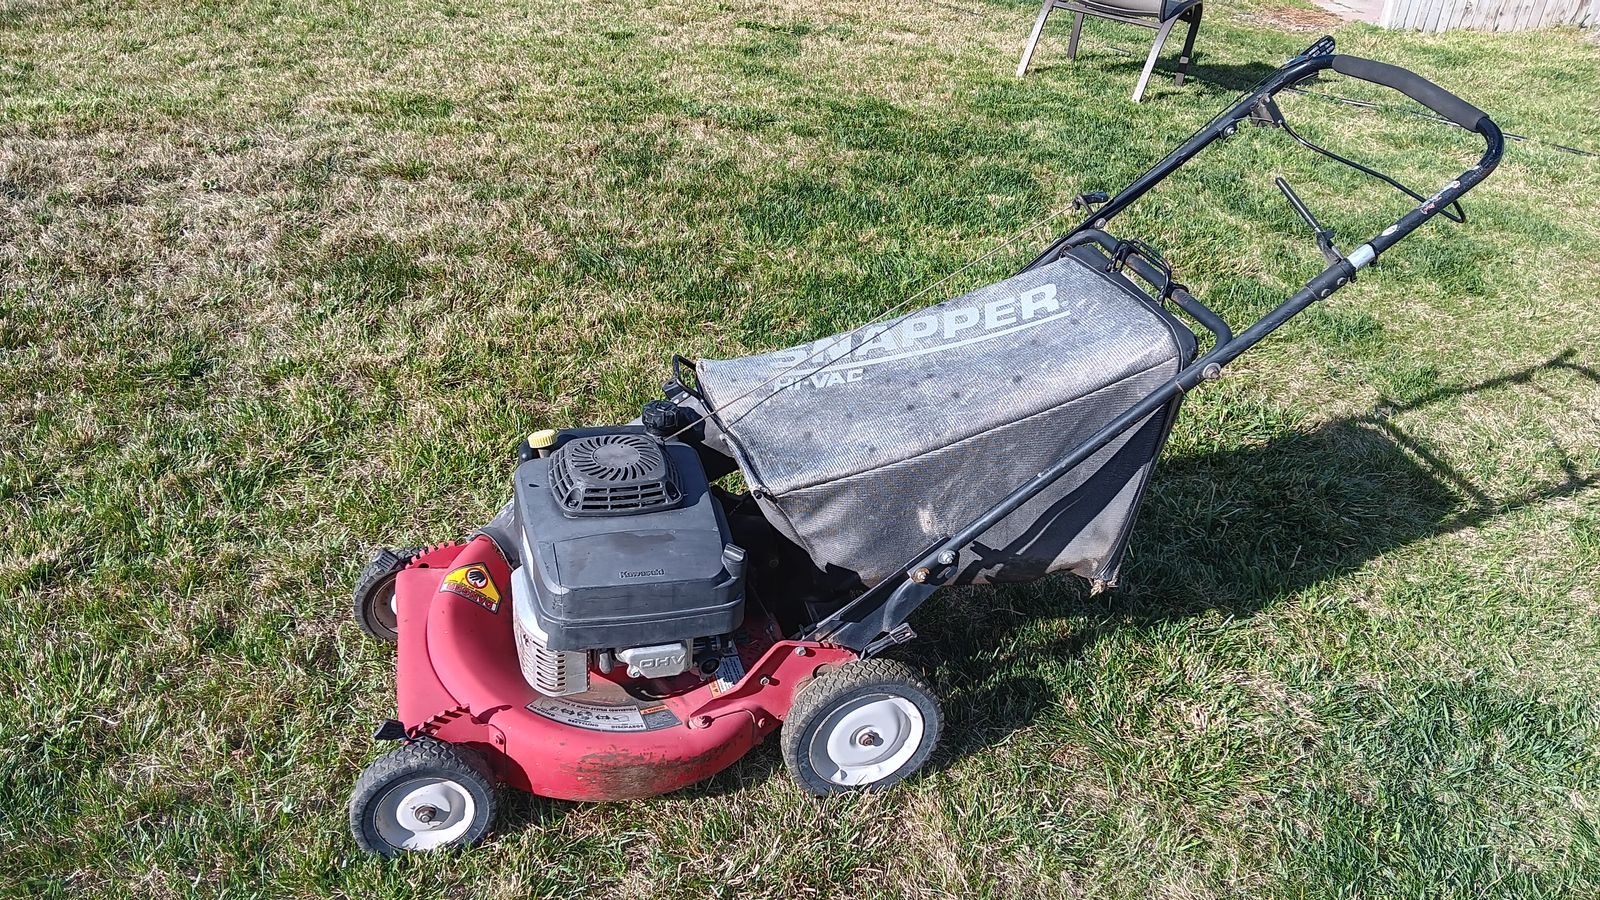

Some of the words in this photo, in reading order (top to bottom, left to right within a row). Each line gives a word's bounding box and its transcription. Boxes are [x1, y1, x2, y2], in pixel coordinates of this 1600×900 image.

[619, 568, 665, 578] Kawasaki
[640, 654, 685, 668] OHV
[567, 718, 599, 727] RECYCLING
